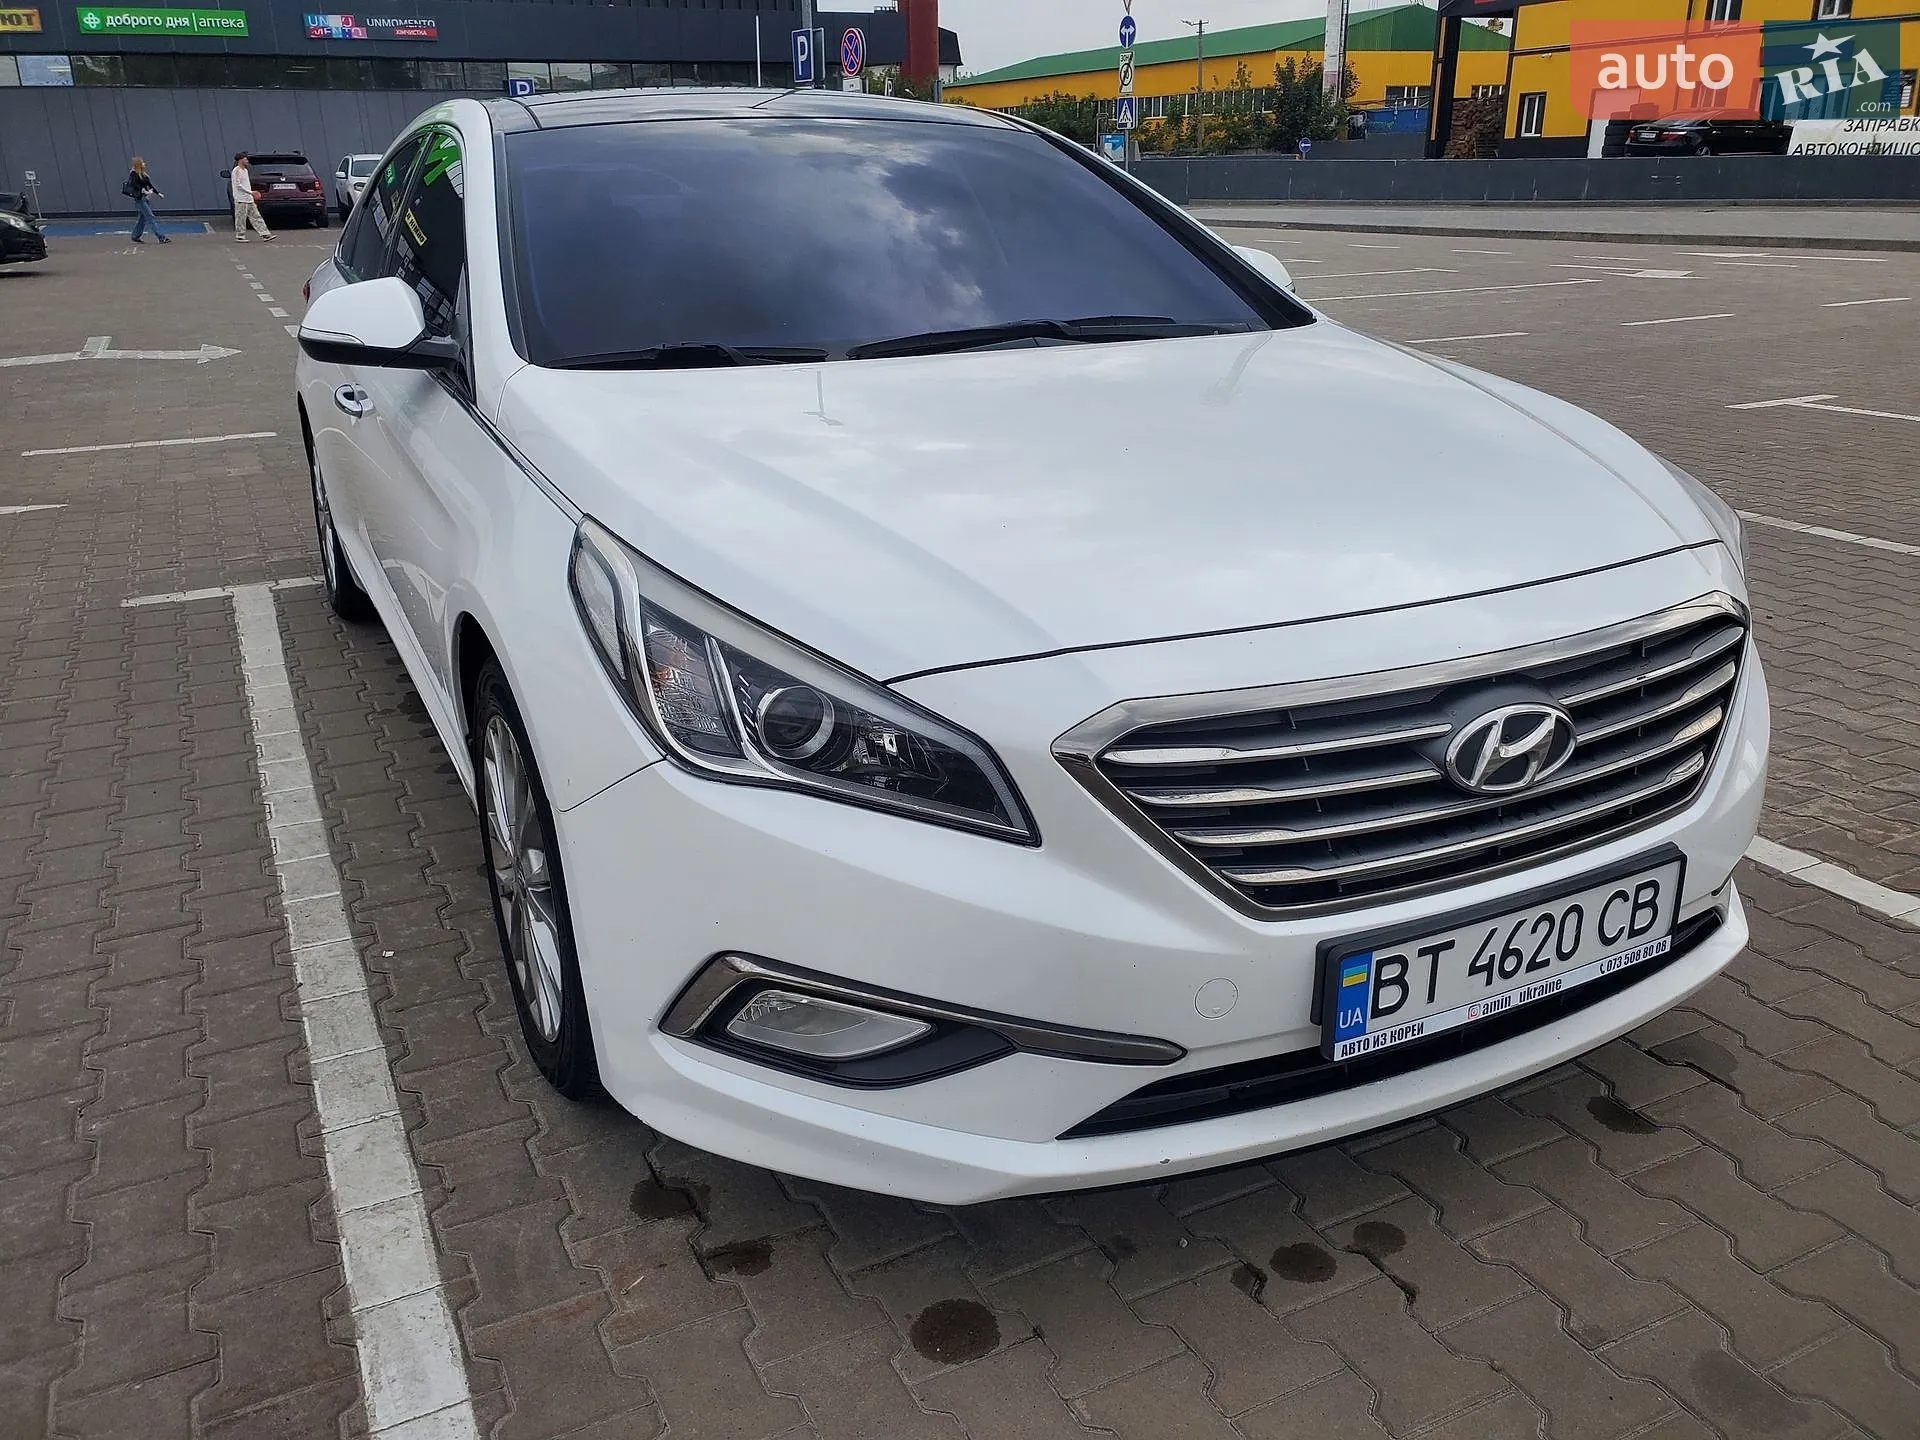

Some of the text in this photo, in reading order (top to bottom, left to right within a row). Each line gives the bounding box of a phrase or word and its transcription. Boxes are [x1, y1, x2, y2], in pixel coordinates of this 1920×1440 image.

[106, 14, 245, 29] доброго дня аптека
[366, 18, 436, 28] UNMOMENTO
[797, 35, 808, 76] P
[1370, 879, 1661, 1020] BT 4620 CB
[1606, 940, 1667, 972] 073 508 80 08
[1339, 1007, 1363, 1029] UA
[1340, 1022, 1424, 1058] АВТО ИЗ КОРЕИ
